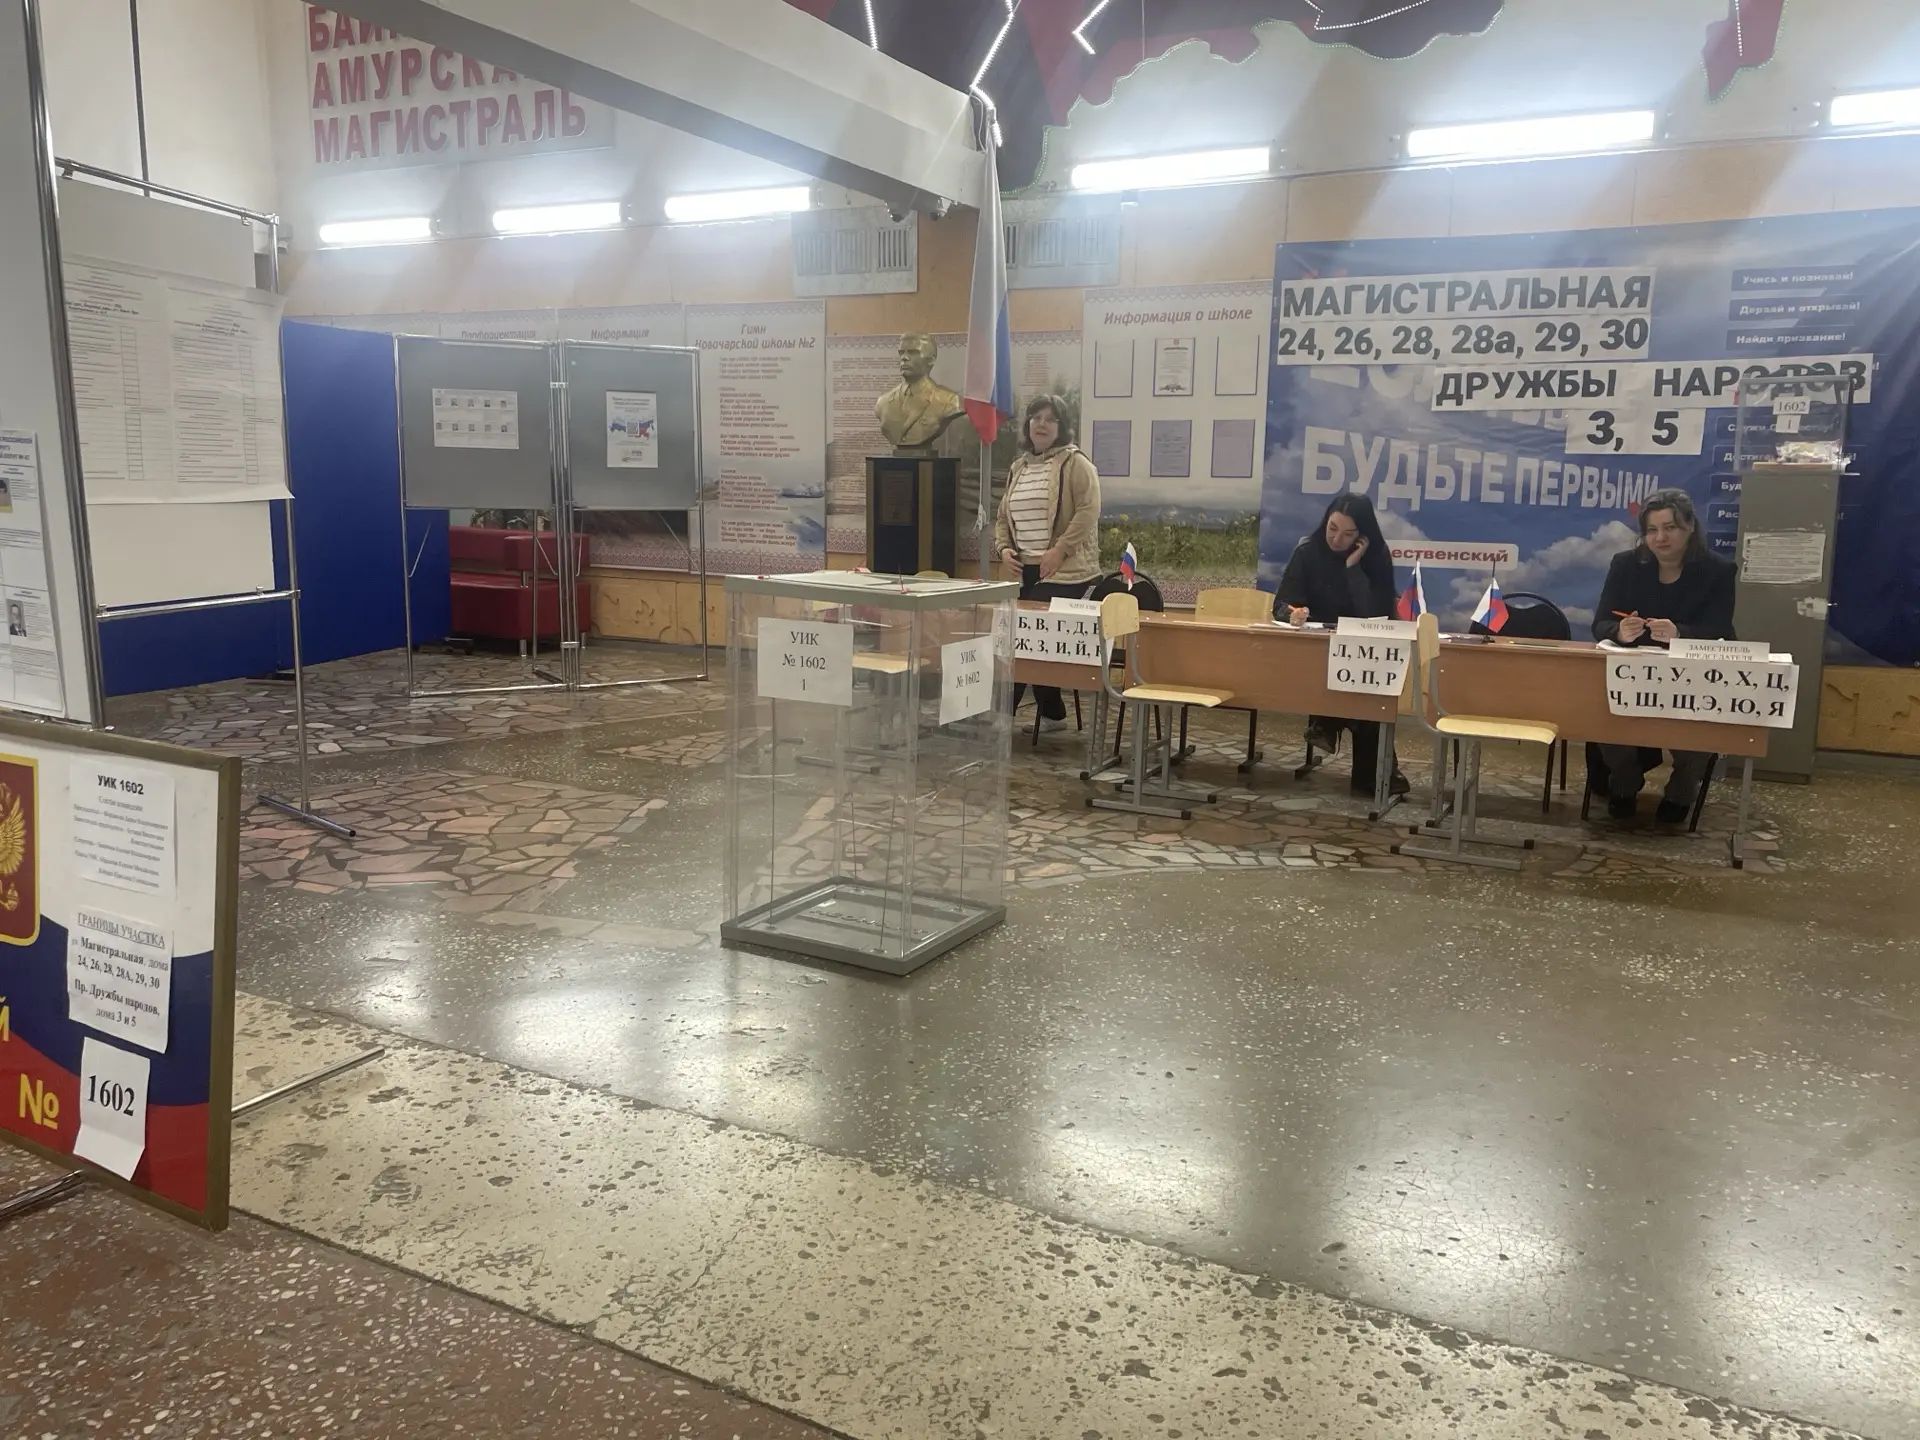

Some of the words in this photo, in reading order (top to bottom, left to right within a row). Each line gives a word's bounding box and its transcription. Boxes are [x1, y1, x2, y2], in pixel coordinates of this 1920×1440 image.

[309, 5, 398, 51] БА
[313, 88, 586, 163] МАГИСТРАЛЬ
[1742, 275, 1777, 285] Учись
[1283, 275, 1651, 318] МАГИСТРАЛЬНАЯ
[1104, 310, 1190, 328] Информация
[1196, 312, 1204, 321] о
[1208, 307, 1253, 321] школе
[1788, 305, 1795, 313] и
[741, 324, 767, 335] Гимн
[1278, 328, 1325, 361] 24,
[1334, 326, 1382, 360] 26,
[1392, 325, 1440, 360] 28,
[1451, 324, 1524, 359] 28а,
[1534, 321, 1589, 357] 29,
[1599, 317, 1649, 351] 30
[1736, 333, 1774, 344] Найди
[1777, 332, 1846, 344] призвание!
[761, 338, 796, 349] школы
[799, 337, 816, 349] №2
[1435, 368, 1617, 406] ДРУЖБЫ
[1653, 360, 1866, 400] НАРОДОВ
[1778, 400, 1806, 412] 1602
[1586, 411, 1623, 452] 3,
[1651, 410, 1679, 447] 5
[1727, 424, 1766, 433] Сужи
[1301, 425, 1505, 512] БУДЬТЕ
[1514, 455, 1659, 510] ПЕРВЫМИ
[1721, 481, 1742, 491] Буд
[1717, 510, 1739, 518] Рас
[1389, 547, 1509, 564] ественский
[1018, 616, 1031, 630] Б,
[1036, 618, 1049, 633] В,
[1057, 620, 1070, 634] Г,
[1073, 622, 1088, 636] Д,
[790, 630, 819, 646] УИК
[1014, 637, 1033, 652] Ж,
[1037, 640, 1049, 654] З,
[1056, 641, 1071, 656] И,
[1076, 640, 1091, 658] Й,
[960, 649, 977, 664] УИК
[1332, 644, 1352, 661] Л,
[1357, 645, 1379, 663] М,
[1386, 647, 1404, 665] Н,
[1688, 643, 1751, 654] ЗАМЕСТИТЕЛЬ
[782, 653, 797, 666] №
[800, 655, 827, 670] 1602
[801, 679, 806, 690] 1
[964, 671, 981, 686] 1602
[1336, 668, 1355, 686] О,
[1362, 670, 1380, 687] П,
[1386, 672, 1397, 686] Р
[1615, 664, 1636, 682] С,
[1642, 665, 1663, 684] Т,
[1670, 667, 1691, 685] У,
[1704, 668, 1729, 686] Ф,
[1735, 670, 1758, 690] Х,
[1766, 672, 1790, 692] Ц,
[1609, 690, 1629, 709] Ч,
[1635, 692, 1664, 711] Ш,
[1730, 697, 1761, 717] Ю,
[1768, 701, 1785, 717] Я
[97, 774, 117, 790] УИК
[119, 779, 145, 796] 1602
[78, 912, 119, 936] ГРАНИЦЫ
[121, 924, 166, 948] УЧАСТКА
[90, 959, 102, 974] 26,
[135, 973, 148, 988] 29,
[149, 976, 160, 990] 30
[75, 978, 87, 994] Пр.
[90, 984, 123, 1003] Дружбы
[125, 997, 160, 1017] народов,
[96, 1008, 115, 1021] дома
[116, 1011, 122, 1023] 3
[124, 1016, 130, 1025] и
[131, 1016, 137, 1028] 5
[19, 1073, 59, 1130] №
[88, 1075, 136, 1117] 1602
